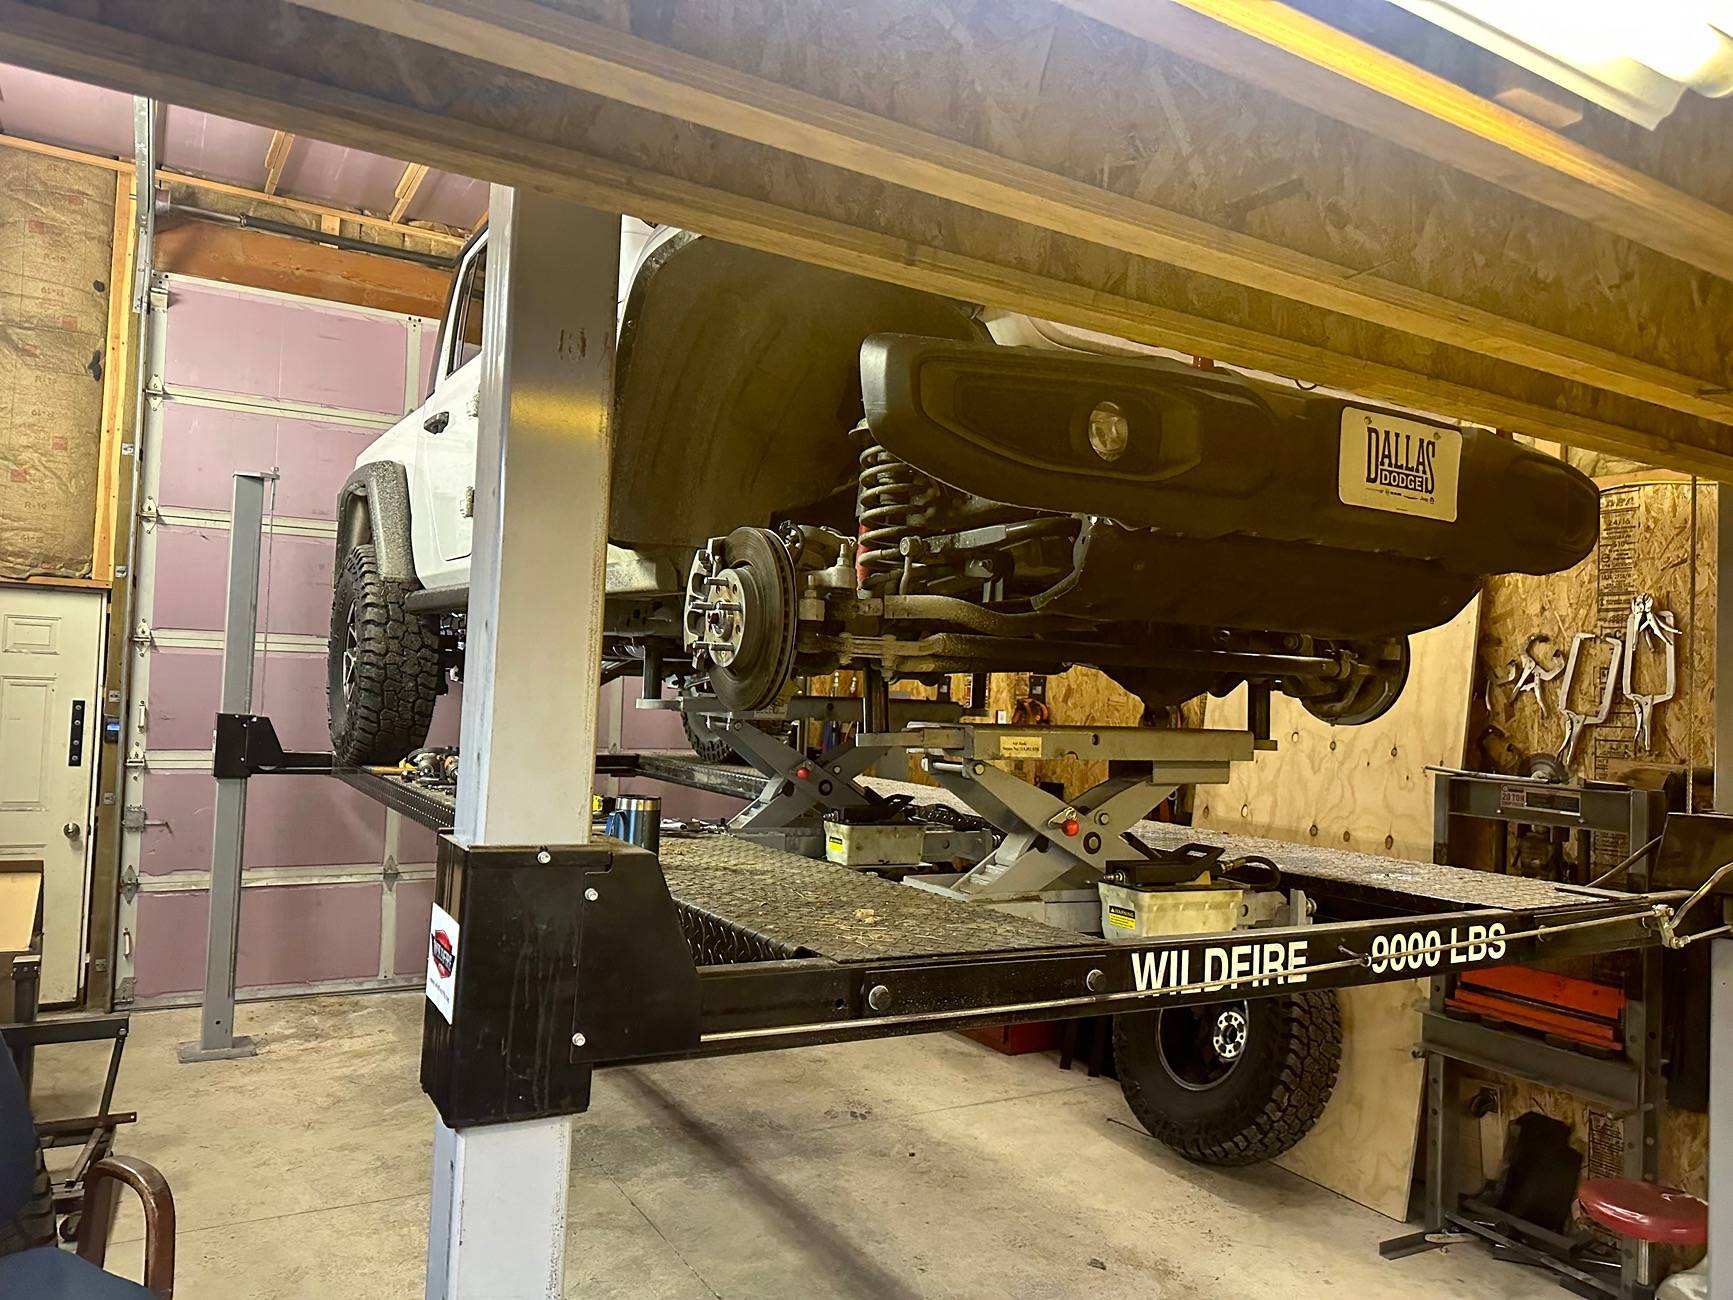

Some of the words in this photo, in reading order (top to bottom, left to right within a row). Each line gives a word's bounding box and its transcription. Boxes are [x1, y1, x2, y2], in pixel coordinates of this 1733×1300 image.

[1365, 426, 1436, 495] DALLAS
[1381, 470, 1423, 490] DODGE
[1131, 940, 1308, 998] WILDFIRE
[1371, 930, 1441, 974] 9000
[1450, 922, 1506, 964] LBS
